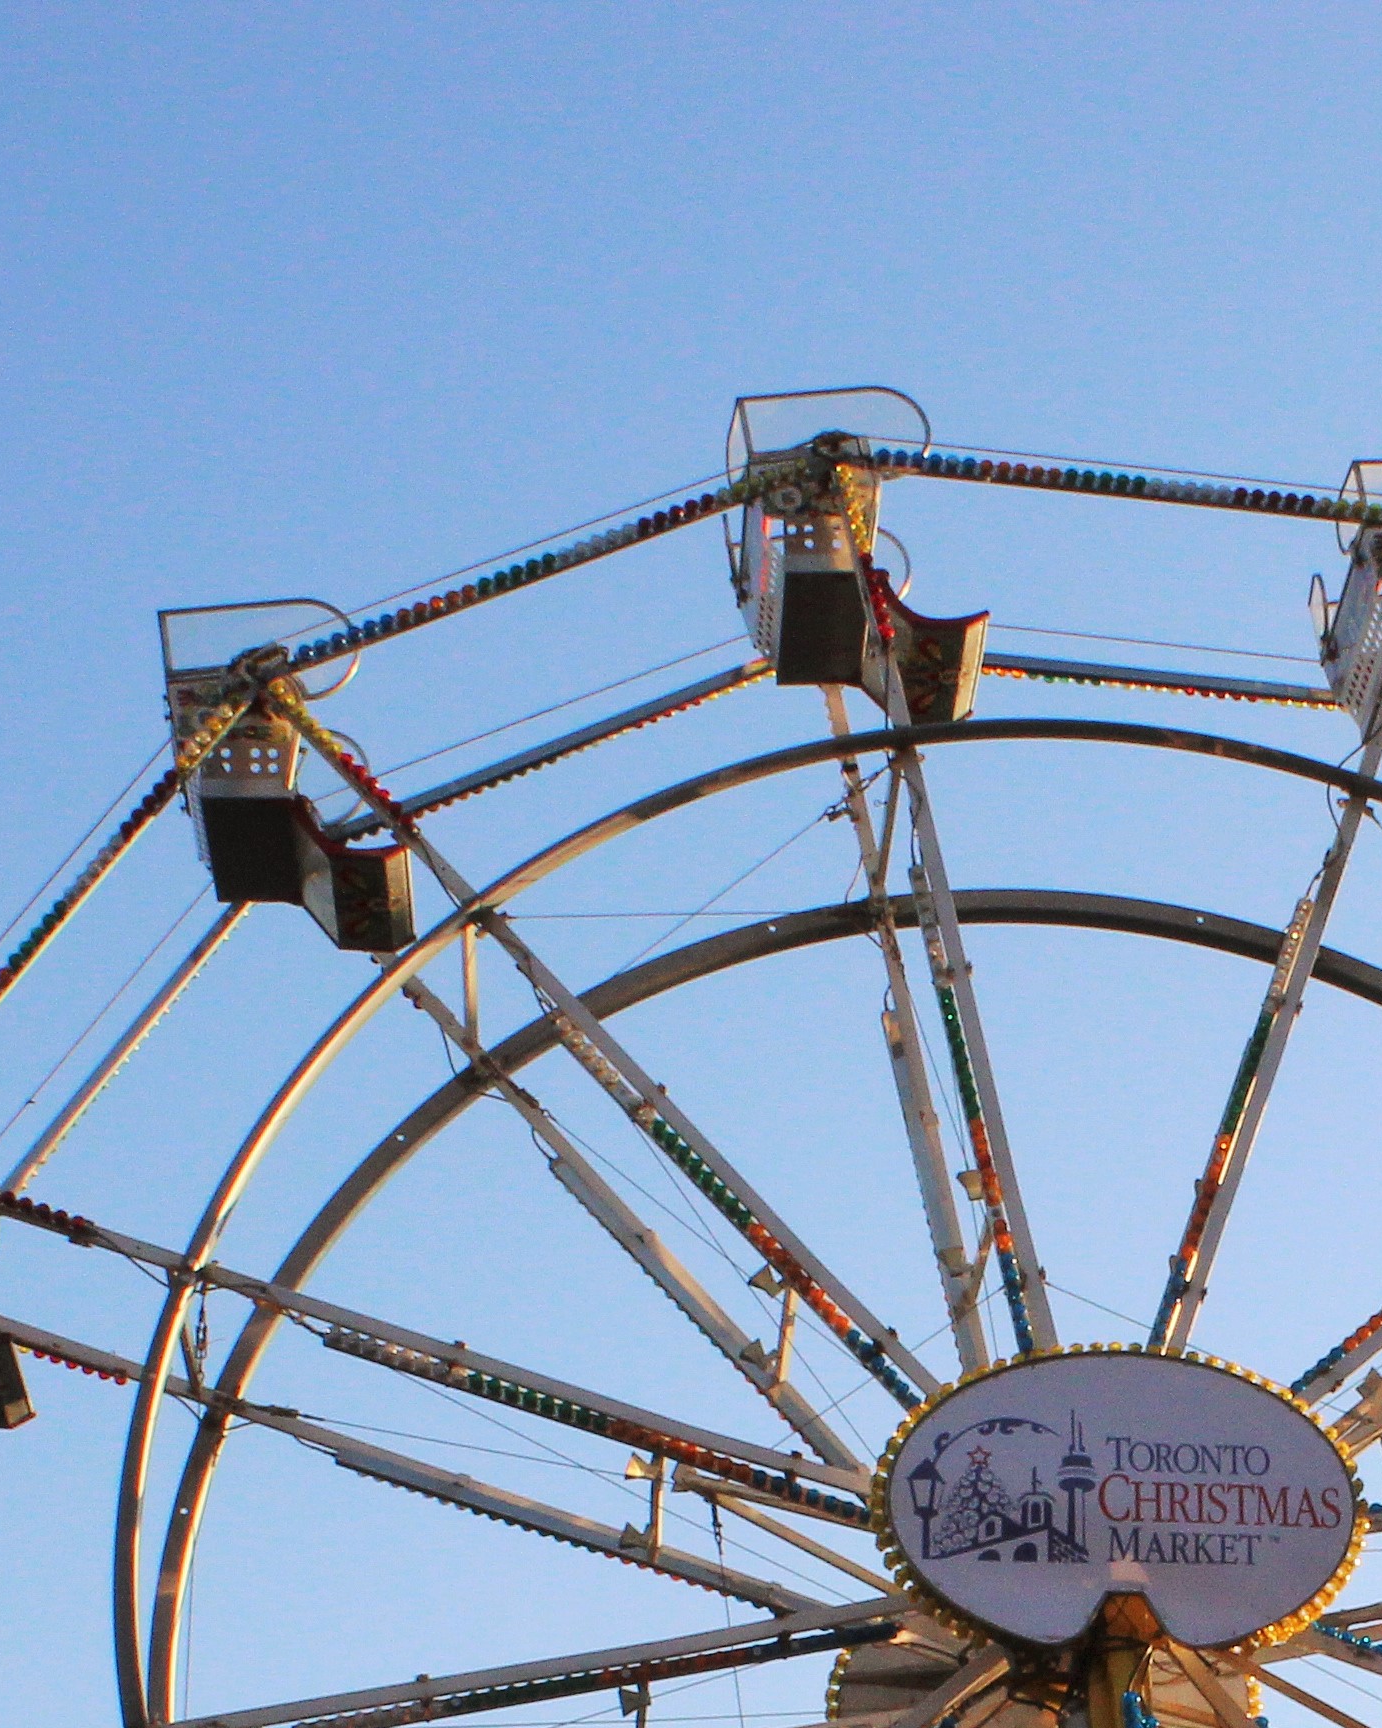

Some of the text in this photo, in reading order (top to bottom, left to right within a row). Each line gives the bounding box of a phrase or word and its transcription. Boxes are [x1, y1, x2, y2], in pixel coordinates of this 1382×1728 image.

[1105, 1436, 1270, 1476] TORONTO
[1097, 1473, 1342, 1528] CHRISTMAS
[1107, 1526, 1261, 1566] MARKET
